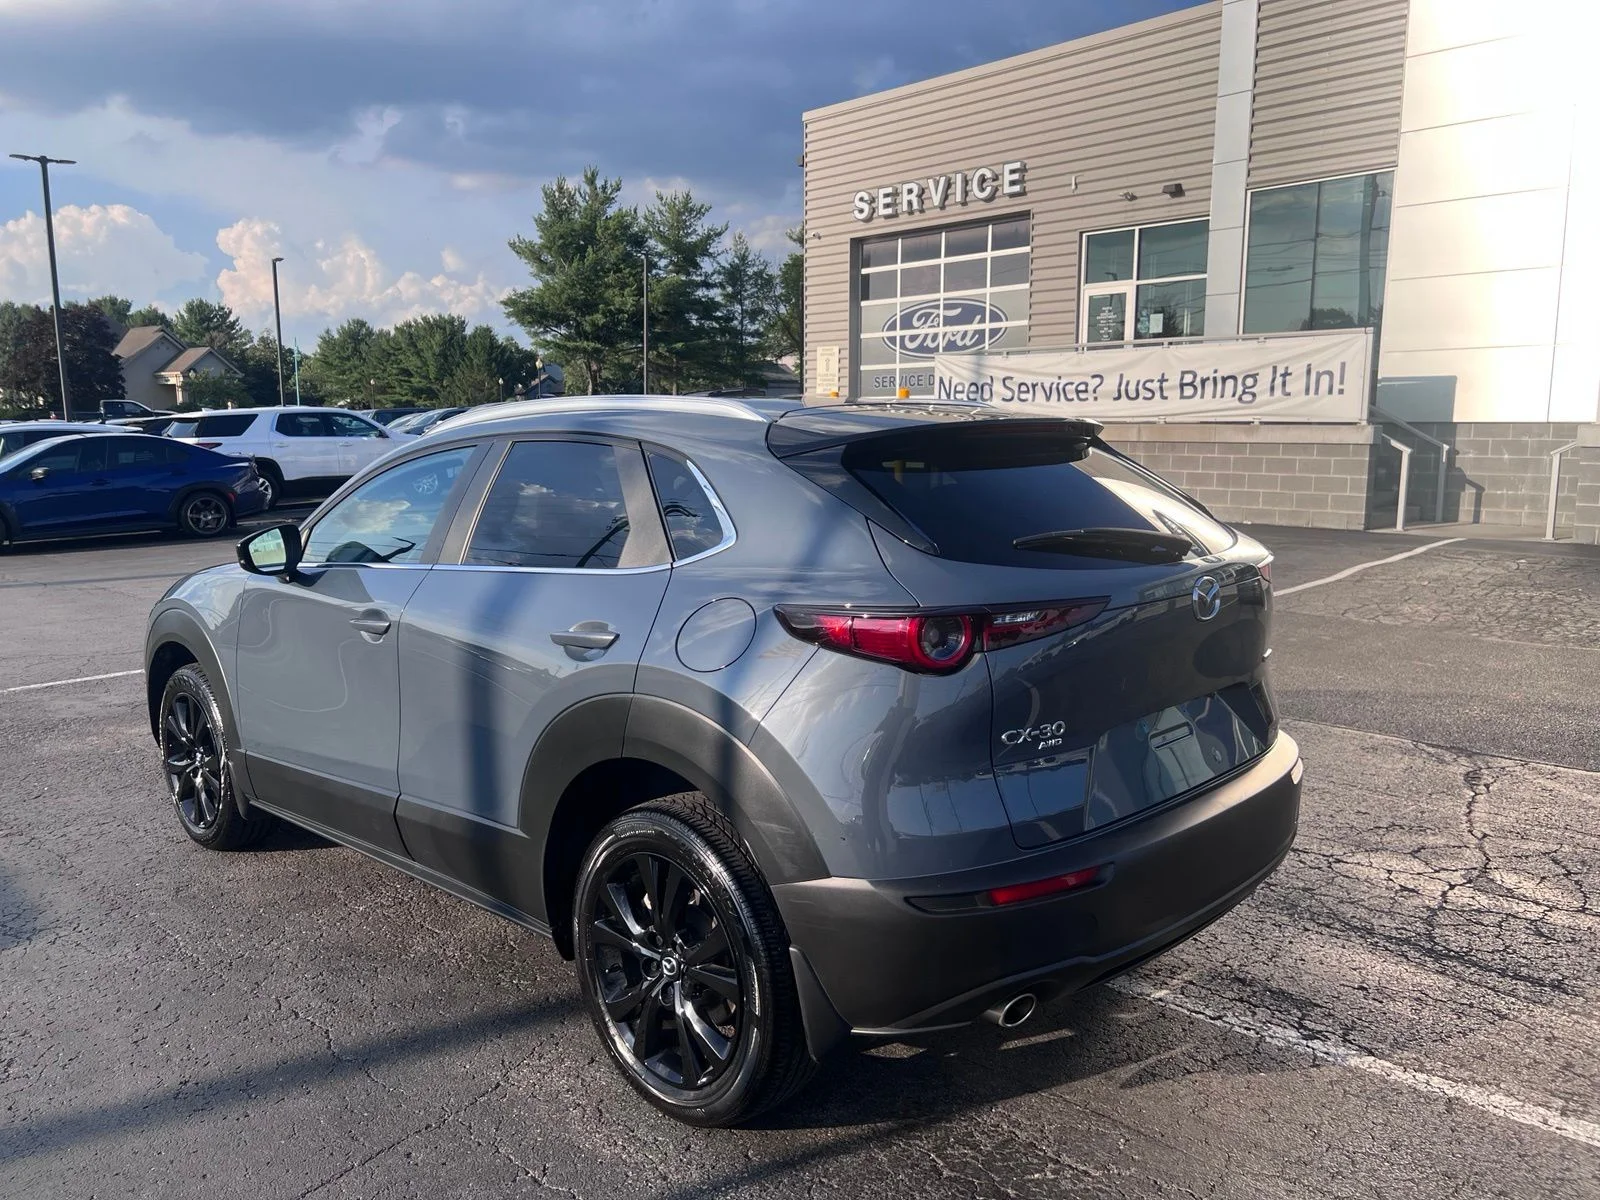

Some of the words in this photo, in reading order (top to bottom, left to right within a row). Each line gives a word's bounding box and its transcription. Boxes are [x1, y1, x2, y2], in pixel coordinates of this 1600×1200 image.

[853, 161, 1026, 222] SERVICE
[904, 307, 982, 350] Ford
[938, 375, 993, 401] Need
[1001, 374, 1104, 402] Service?
[1112, 372, 1169, 401] Just
[1179, 369, 1259, 404] Bring
[1269, 365, 1293, 397] It
[1304, 361, 1346, 396] In!
[1001, 720, 1066, 744] CX-30
